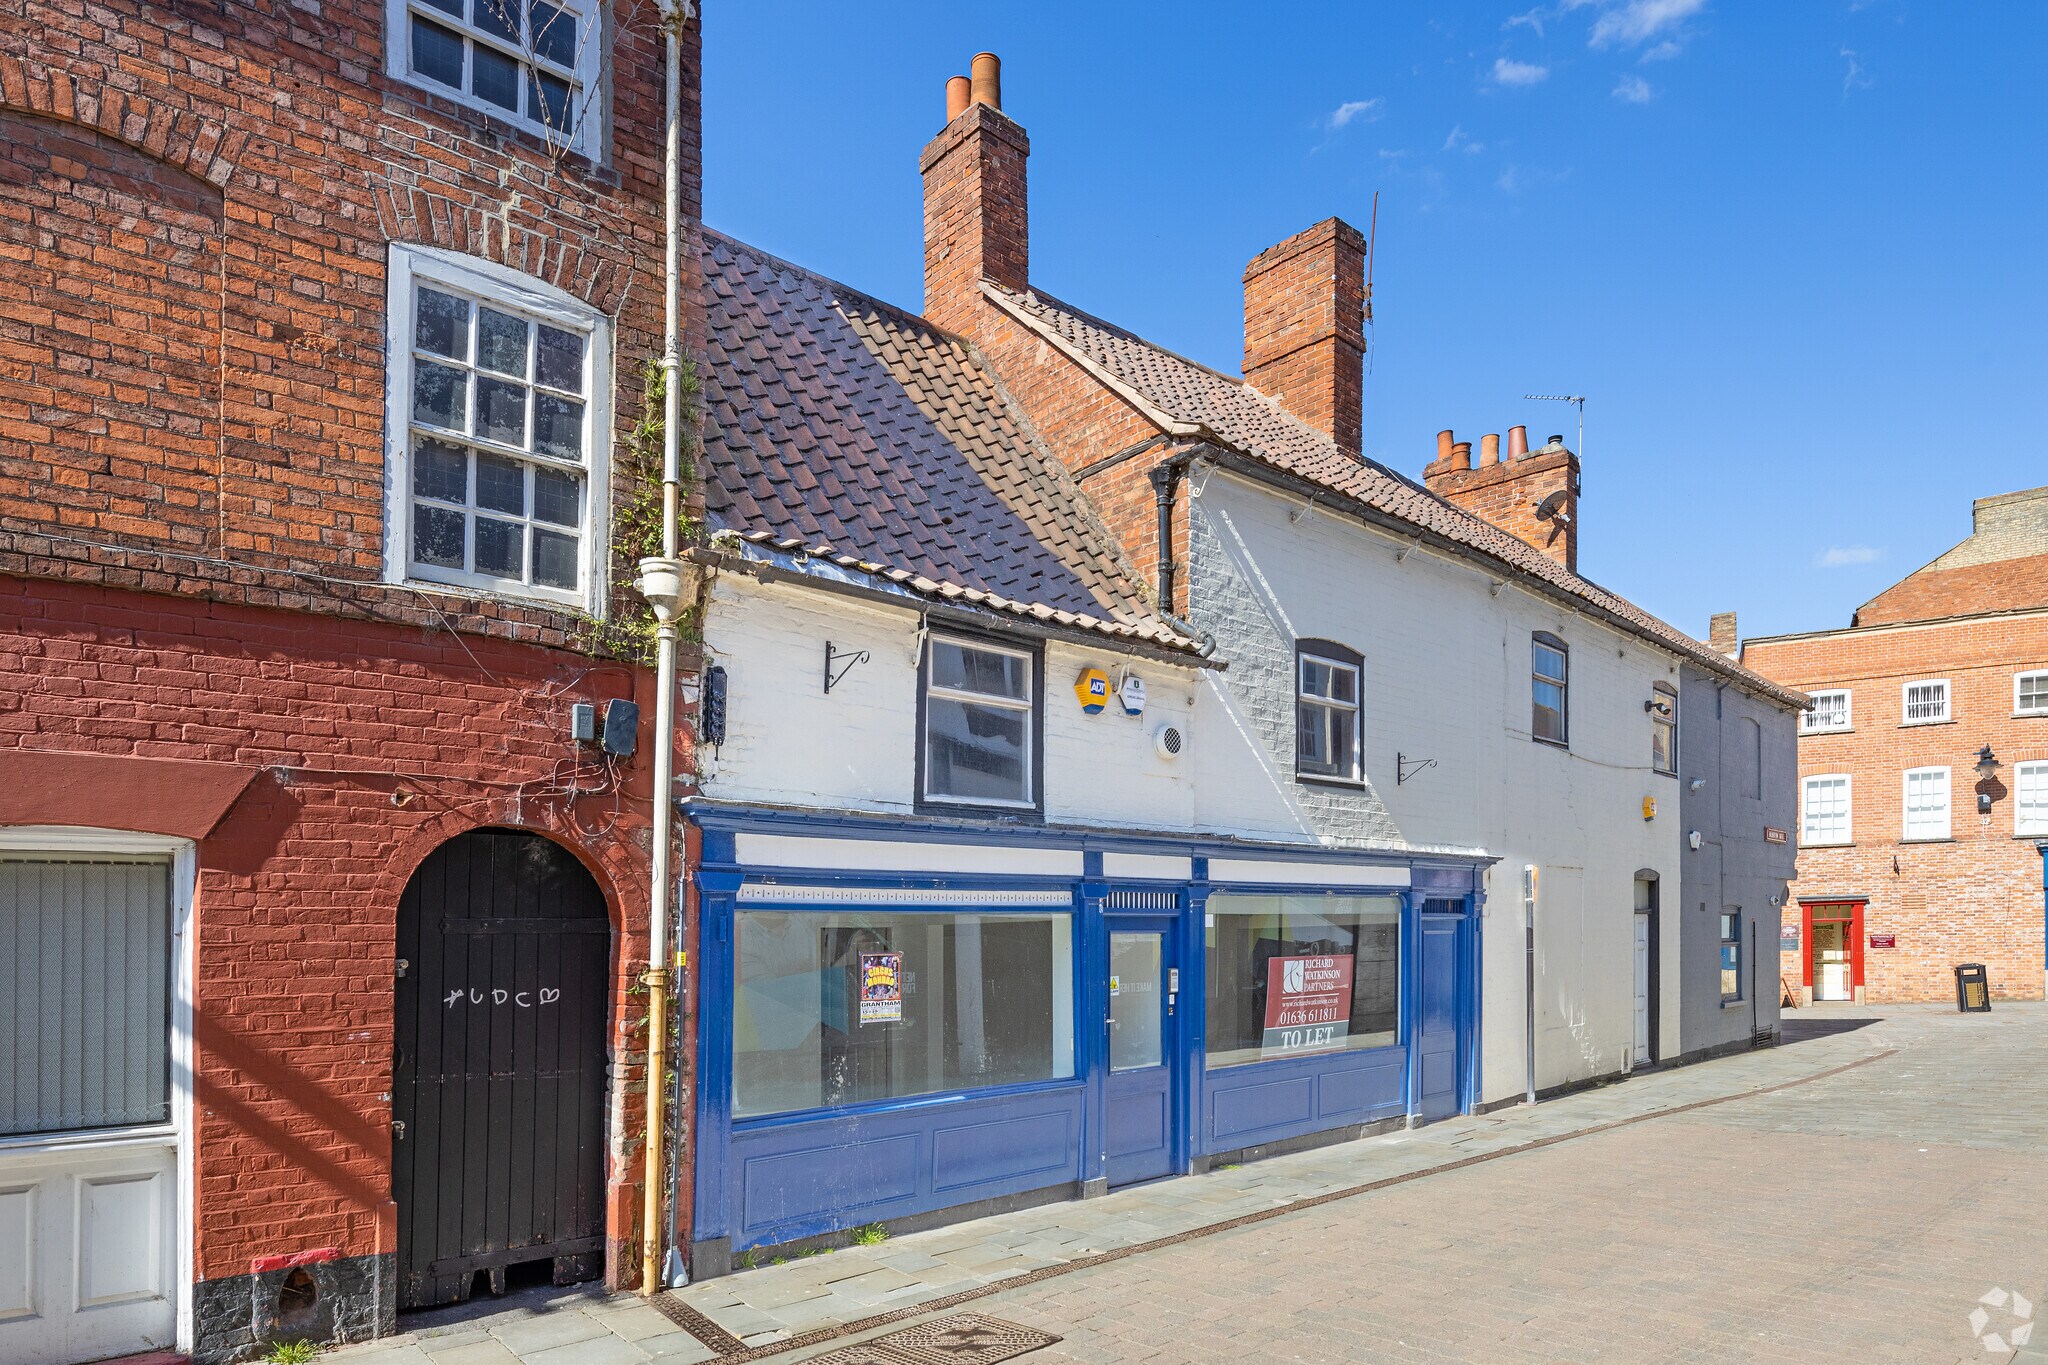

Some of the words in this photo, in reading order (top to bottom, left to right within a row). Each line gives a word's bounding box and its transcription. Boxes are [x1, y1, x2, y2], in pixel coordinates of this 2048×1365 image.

[1091, 682, 1105, 693] ADT
[1305, 959, 1333, 969] RICHARD
[868, 965, 893, 977] CIRCUS
[1304, 969, 1340, 980] WATKINSON
[1304, 981, 1334, 992] PARTNERS
[1280, 1010, 1306, 1025] 01636
[1308, 1007, 1337, 1022] 611811
[1281, 1030, 1301, 1049] TO
[1304, 1027, 1334, 1047] LET
